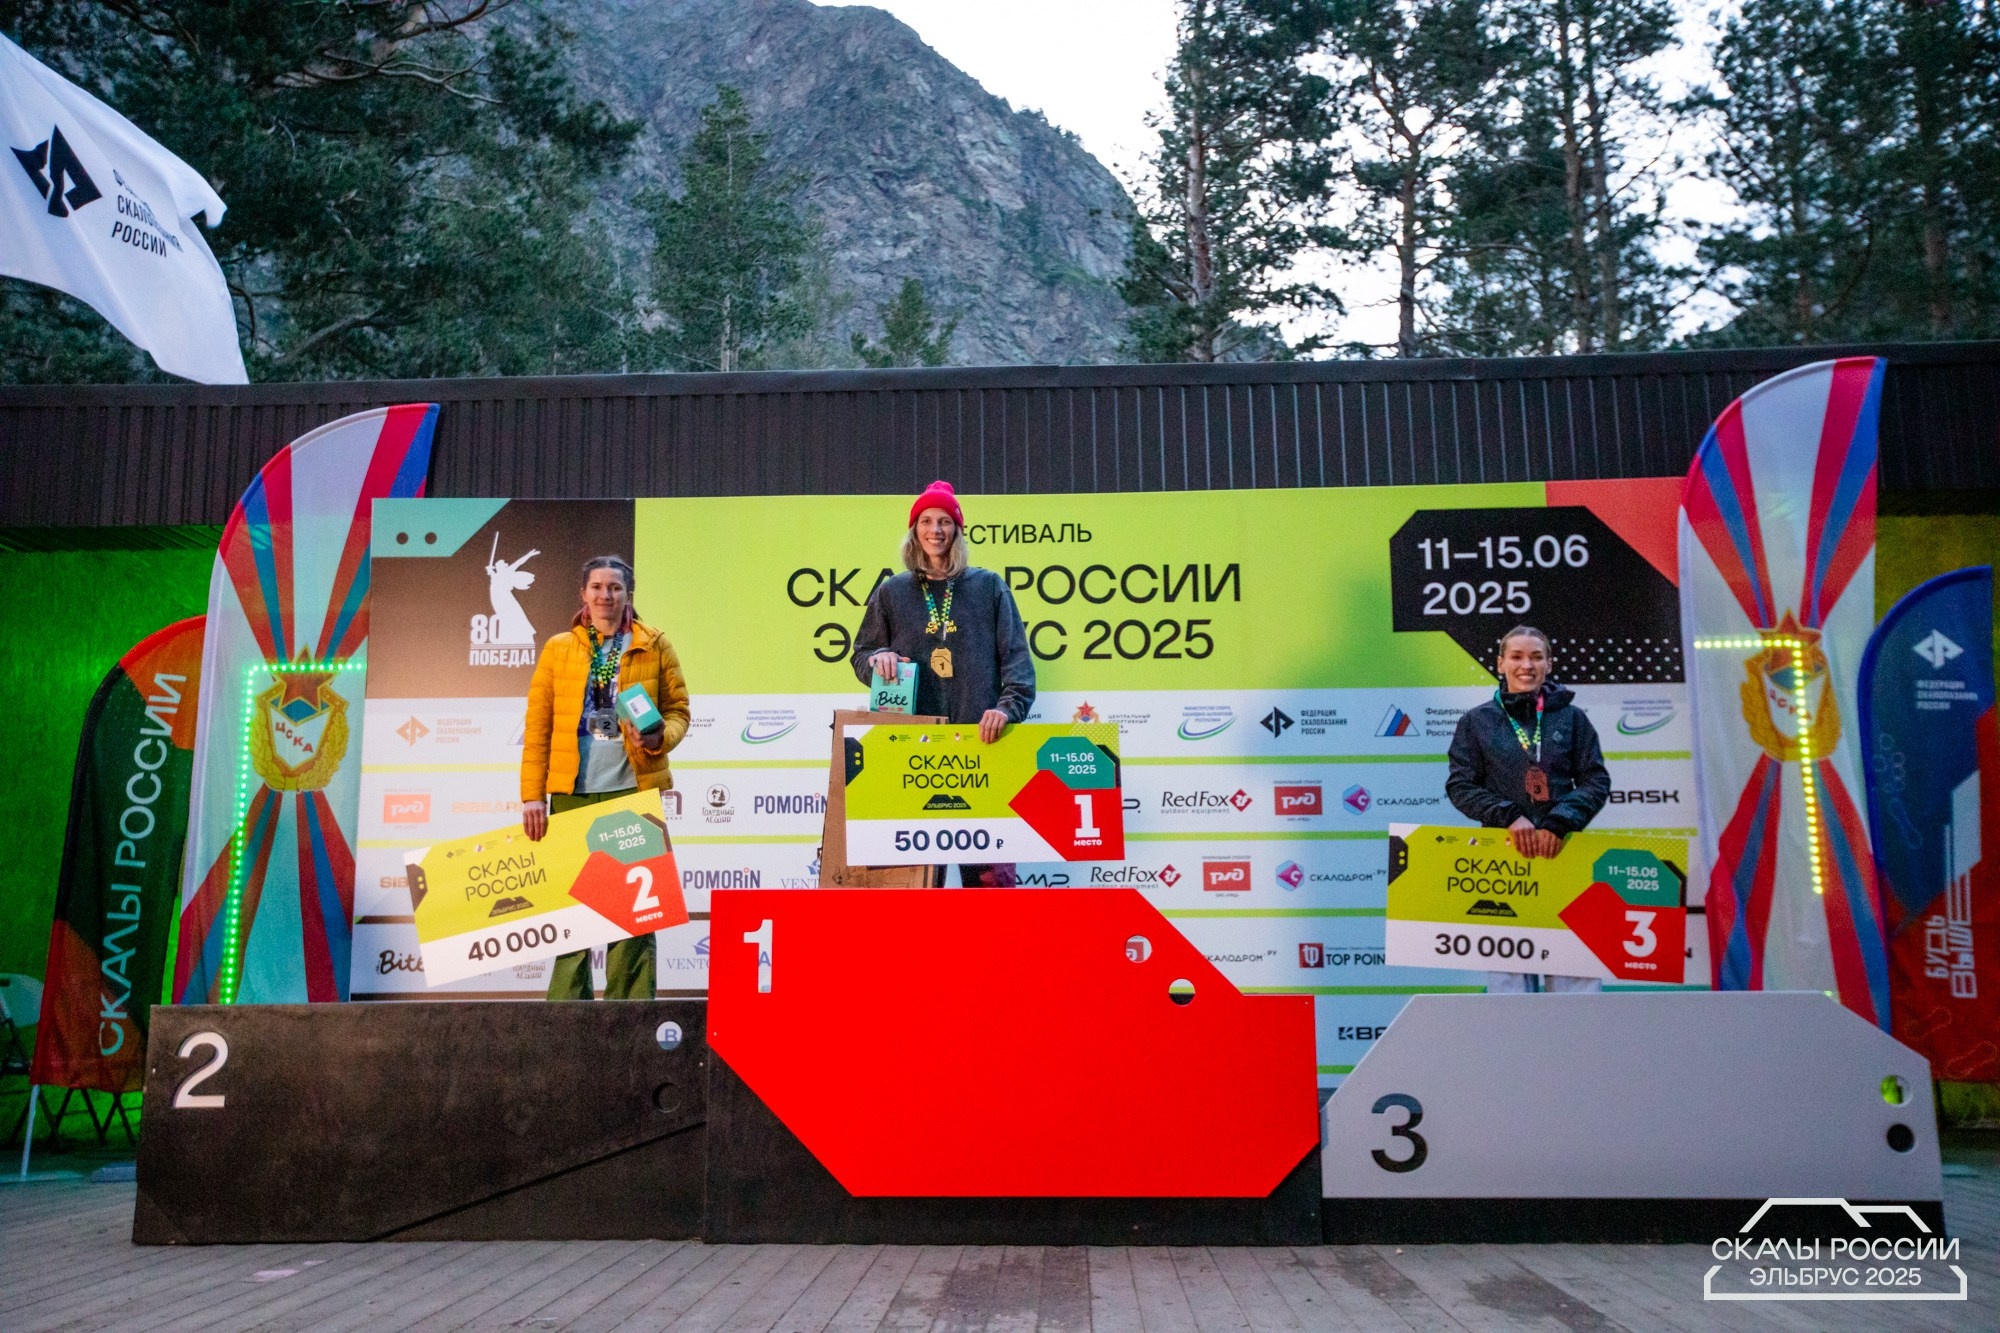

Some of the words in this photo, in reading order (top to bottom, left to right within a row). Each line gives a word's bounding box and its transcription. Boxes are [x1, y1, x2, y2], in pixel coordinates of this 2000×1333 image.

[111, 220, 167, 258] РОССИИ
[963, 523, 1092, 546] ЕСТИВАЛЬ
[1417, 535, 1590, 571] 11–15.06
[787, 567, 895, 607] СКА
[1005, 563, 1241, 605] РОССИИ
[1422, 581, 1532, 616] 2025
[1083, 619, 1214, 660] 2025
[469, 649, 536, 667] ПОБЕДА!
[939, 661, 945, 671] 1
[878, 690, 908, 706] Bite
[1301, 709, 1337, 717] ФЕДЕРАЦИЯ
[603, 721, 611, 730] 2
[275, 721, 314, 753] ЦСКА
[908, 754, 981, 771] СКАЛЫ
[1050, 753, 1094, 763] 11–15.06
[115, 672, 187, 868] РОССИИ
[1068, 764, 1097, 775] 2025
[903, 773, 989, 789] РОССИИ
[1162, 791, 1228, 807] RedFox
[1609, 790, 1679, 804] BASK
[1073, 794, 1100, 838] 1
[598, 823, 642, 843] 11–15.06
[618, 835, 646, 850] 2025
[895, 830, 930, 851] 50
[936, 829, 990, 850] 000
[468, 852, 536, 881] СКАЛЫ
[1091, 866, 1157, 883] RedFox
[1455, 858, 1531, 877] СКАЛЫ
[1608, 866, 1658, 877] 11–15.06
[465, 868, 547, 901] РОССИИ
[626, 866, 660, 912] 2
[1447, 877, 1539, 896] РОССИИ
[1627, 880, 1660, 891] 2025
[635, 911, 663, 924] место
[468, 937, 501, 961] 40
[506, 923, 557, 953] 000
[1622, 910, 1657, 958] 3
[744, 918, 773, 993] 1
[1435, 933, 1471, 955] 30
[1477, 936, 1535, 960] 000
[1925, 915, 1949, 979] БУДЬ
[99, 881, 143, 1056] СКАЛЫ
[1326, 954, 1350, 965] TOP
[1354, 954, 1386, 965] POIN
[173, 1031, 228, 1108] 2
[1371, 1093, 1428, 1173] 3
